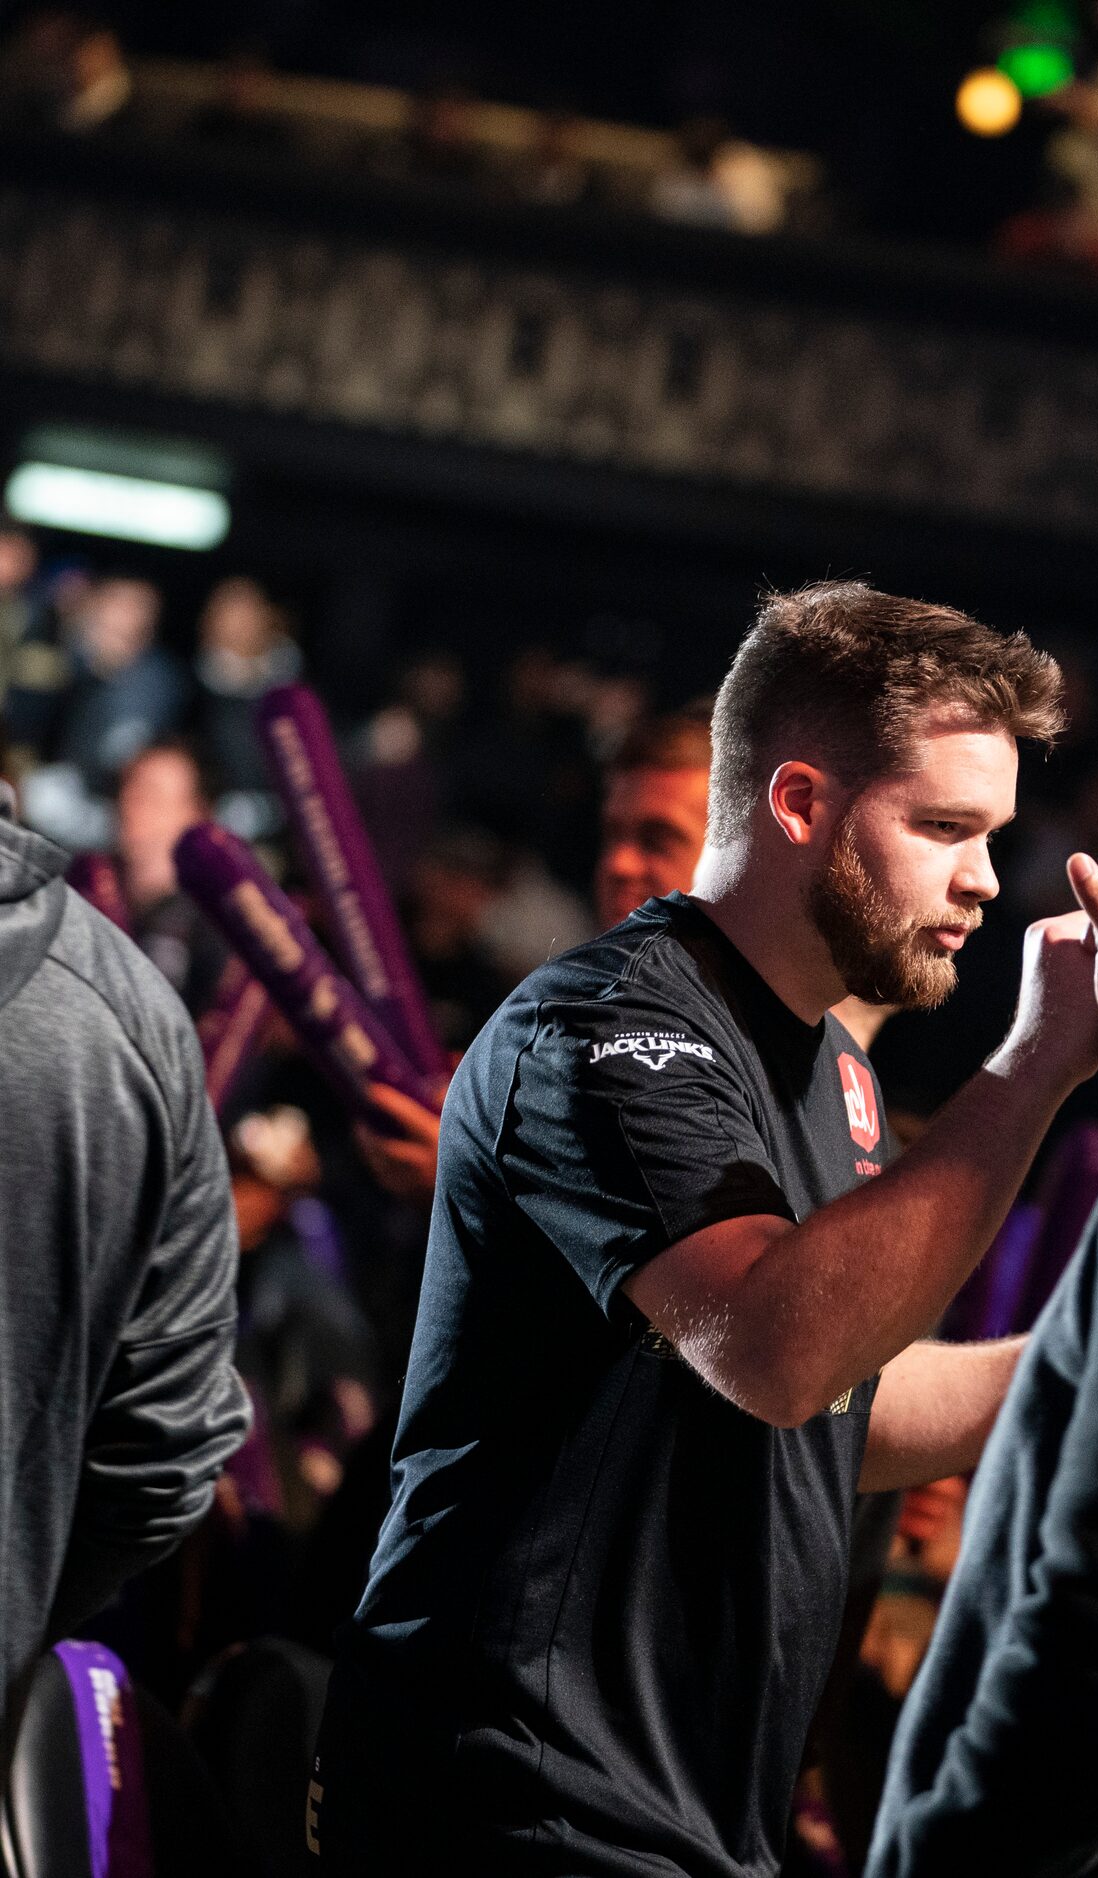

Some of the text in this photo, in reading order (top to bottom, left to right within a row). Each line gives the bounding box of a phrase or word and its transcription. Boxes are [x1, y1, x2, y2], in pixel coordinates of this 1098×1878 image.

[653, 1031, 686, 1039] SNACKS
[589, 1036, 714, 1064] JACK LINK'S
